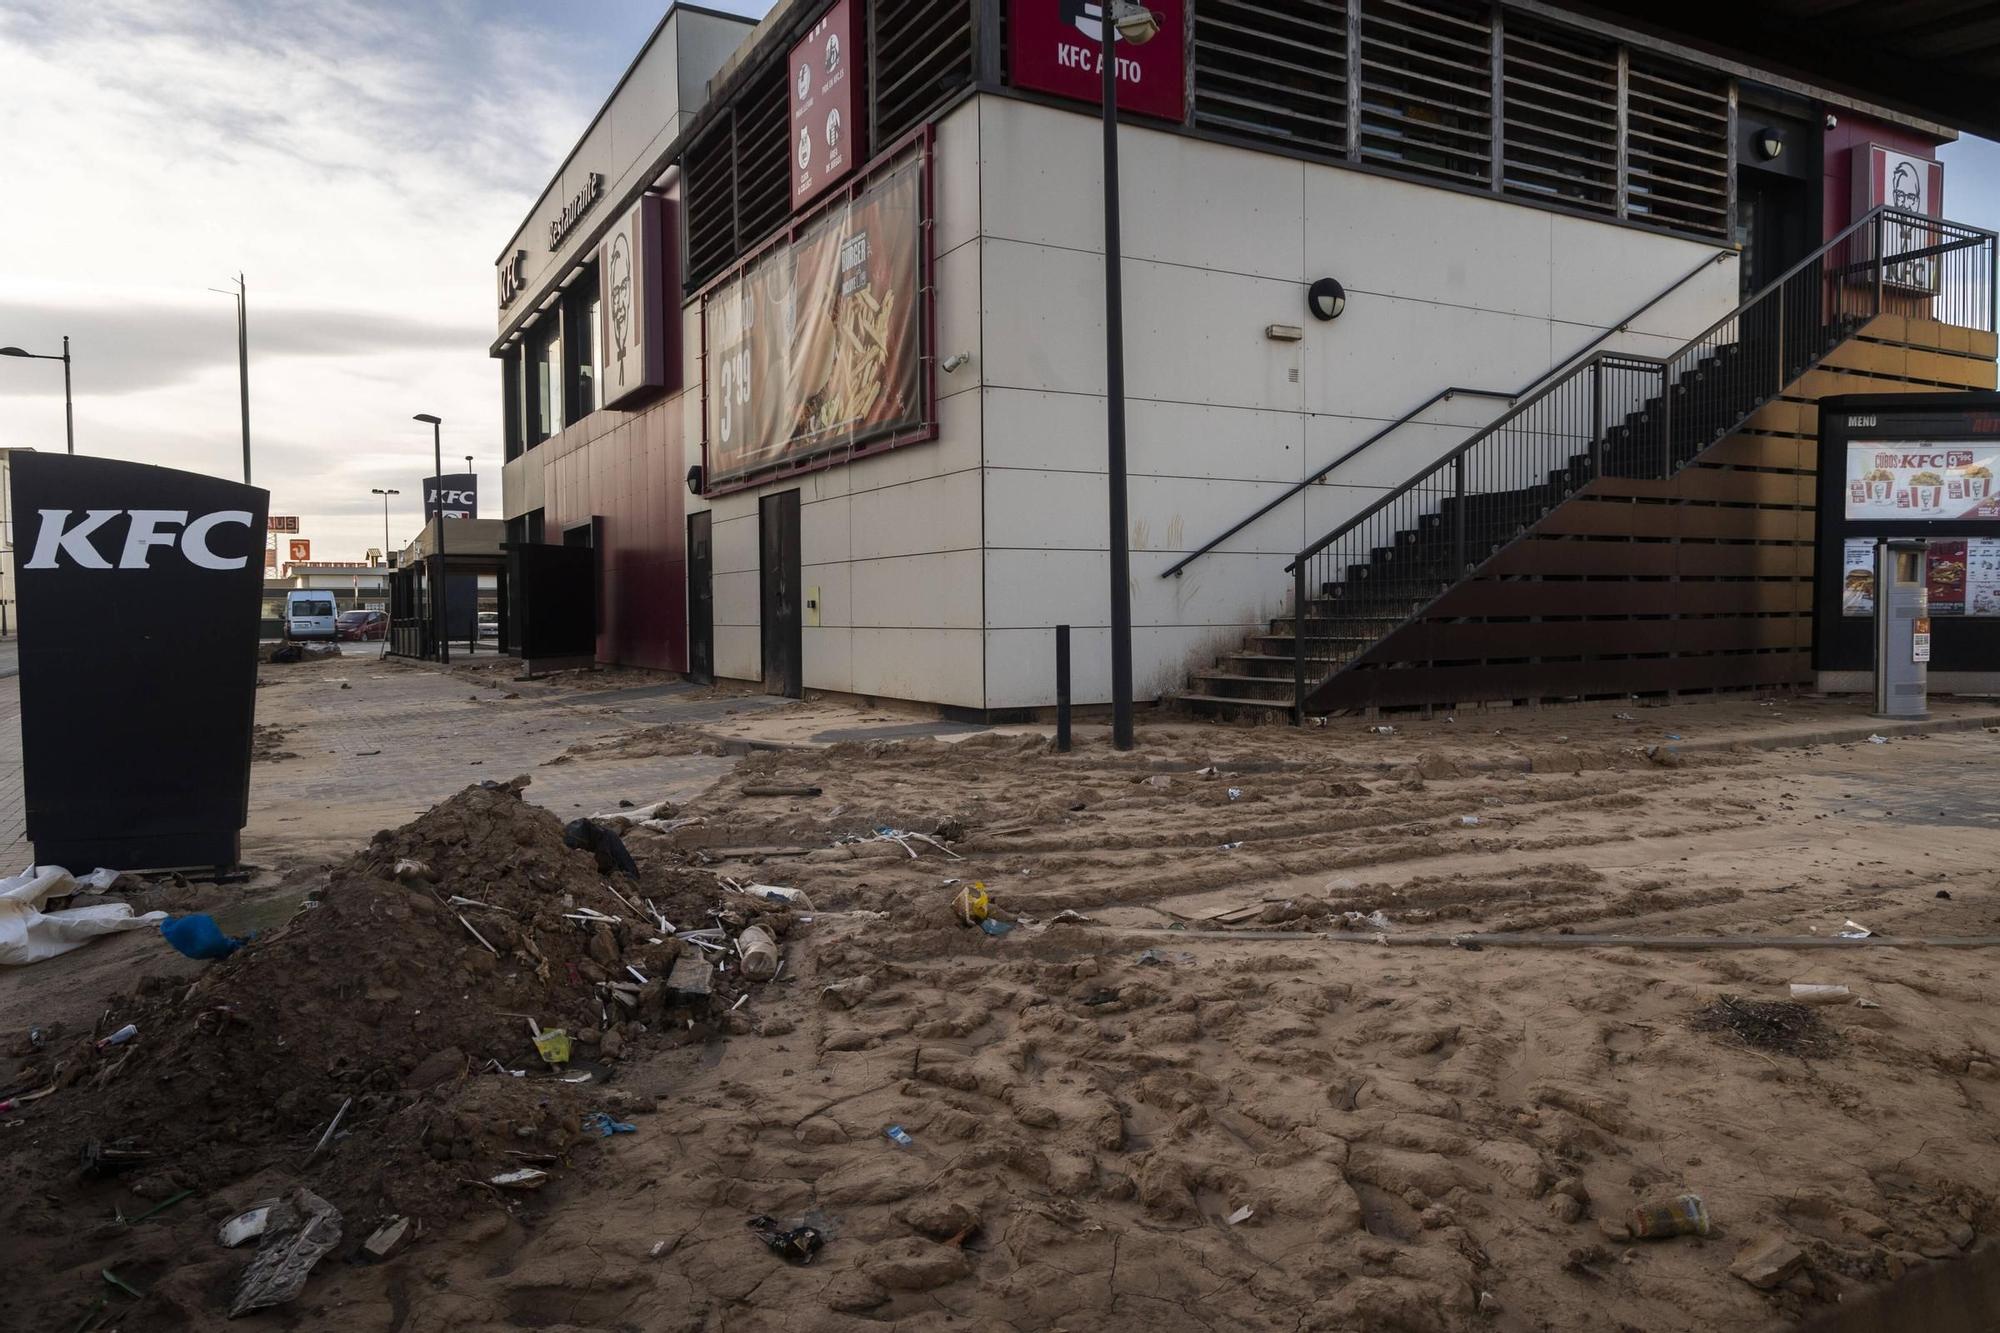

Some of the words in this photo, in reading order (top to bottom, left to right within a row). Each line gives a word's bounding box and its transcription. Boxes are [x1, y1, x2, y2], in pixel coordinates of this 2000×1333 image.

[1058, 42, 1091, 71] KFC
[500, 249, 526, 309] KFC
[1900, 454, 1944, 469] KFC
[427, 489, 475, 505] KFC
[23, 509, 254, 570] KFC
